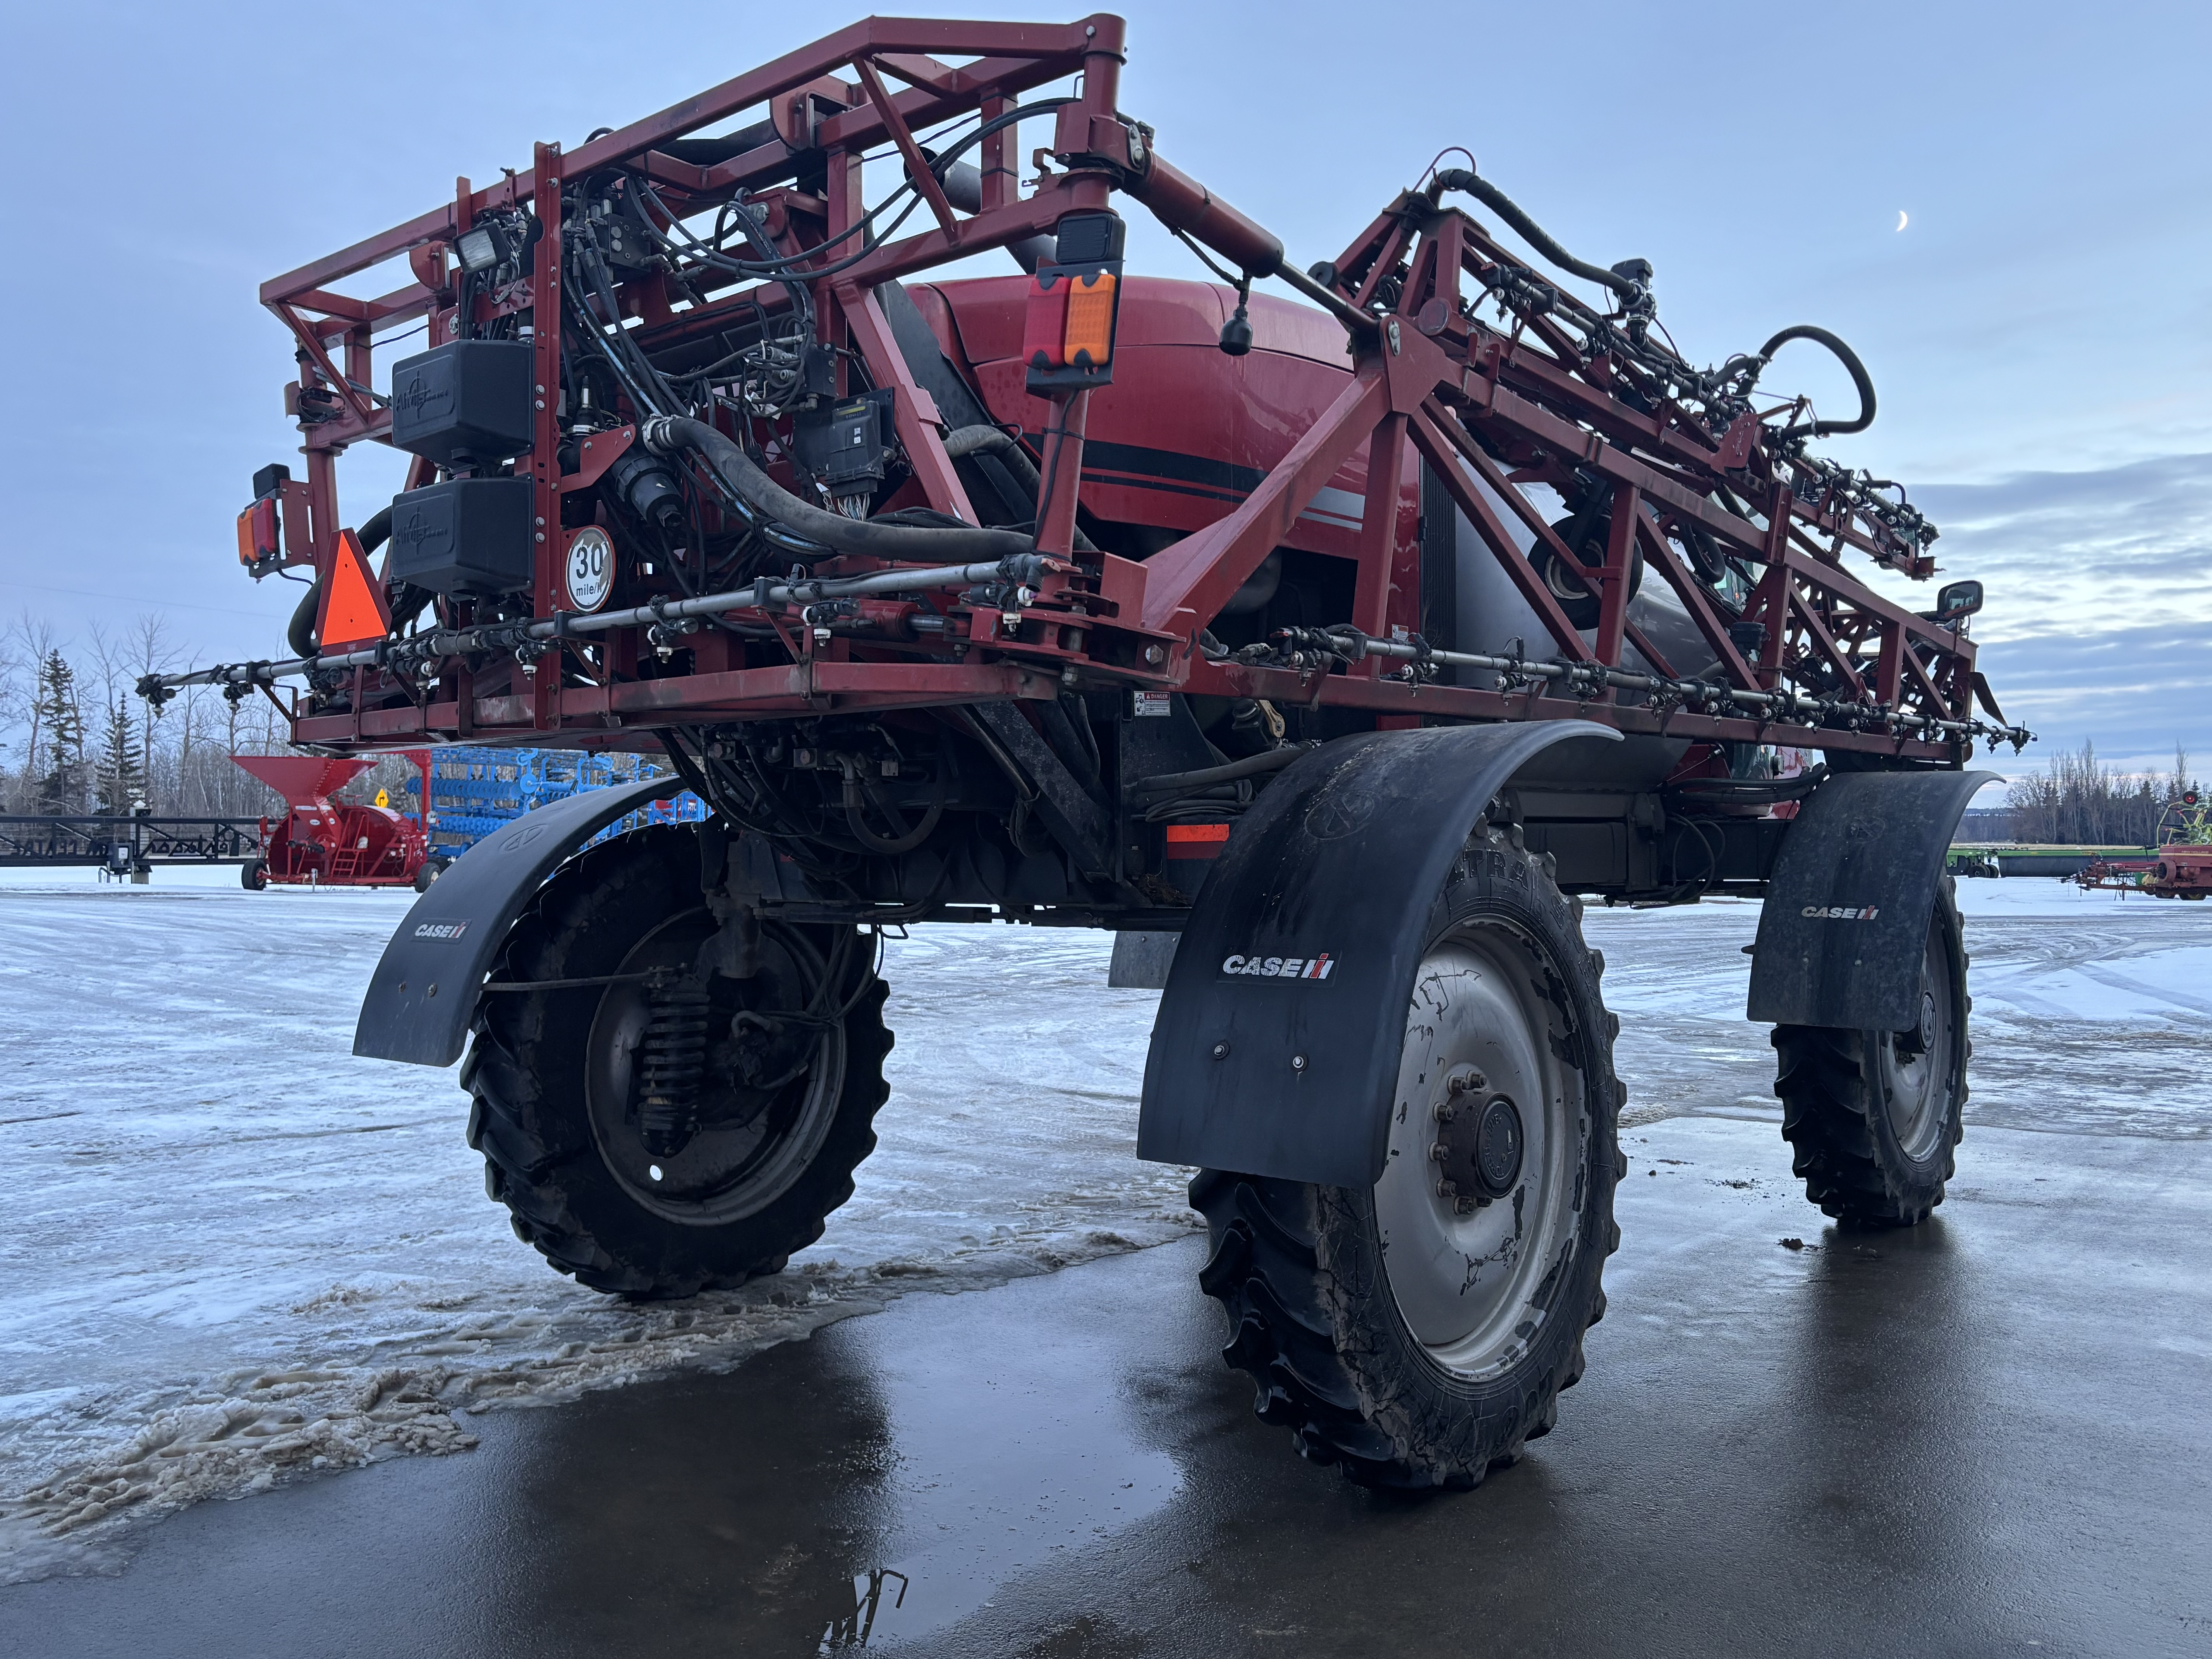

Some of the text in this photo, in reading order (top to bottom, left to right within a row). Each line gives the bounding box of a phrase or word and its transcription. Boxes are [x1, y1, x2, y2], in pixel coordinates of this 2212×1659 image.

[576, 543, 604, 579] 30
[1801, 906, 1858, 919] CASE
[415, 924, 454, 938] CASE
[1223, 955, 1304, 977] CASE
